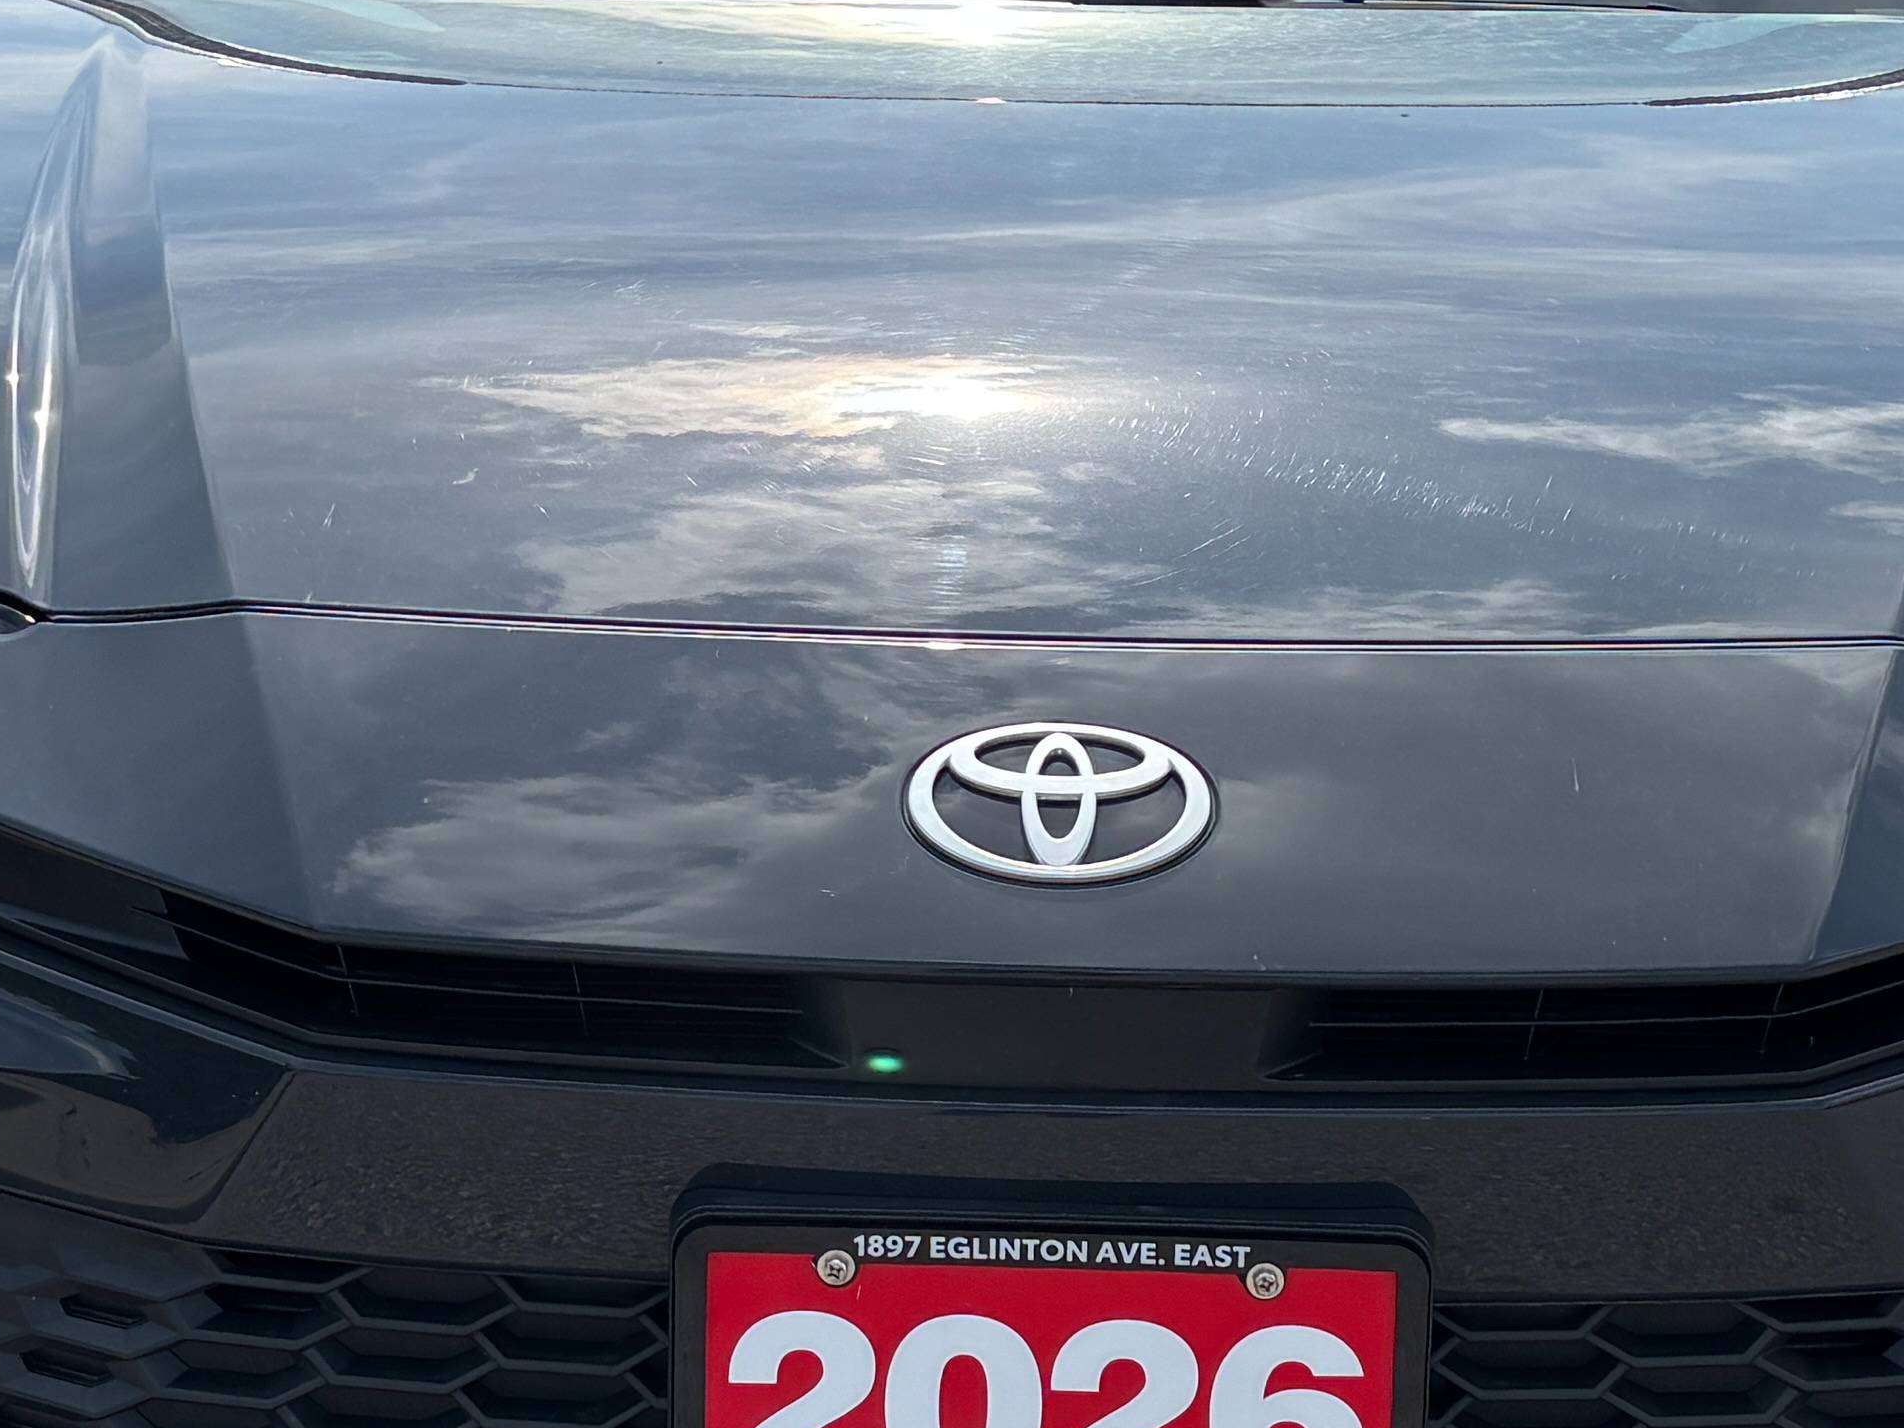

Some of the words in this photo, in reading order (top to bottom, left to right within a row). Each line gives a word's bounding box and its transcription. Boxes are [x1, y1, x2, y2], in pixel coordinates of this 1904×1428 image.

[853, 1234, 922, 1259] 1897
[929, 1237, 1088, 1264] EGLINTON
[1095, 1241, 1166, 1266] AVE.
[1174, 1243, 1252, 1269] EAST
